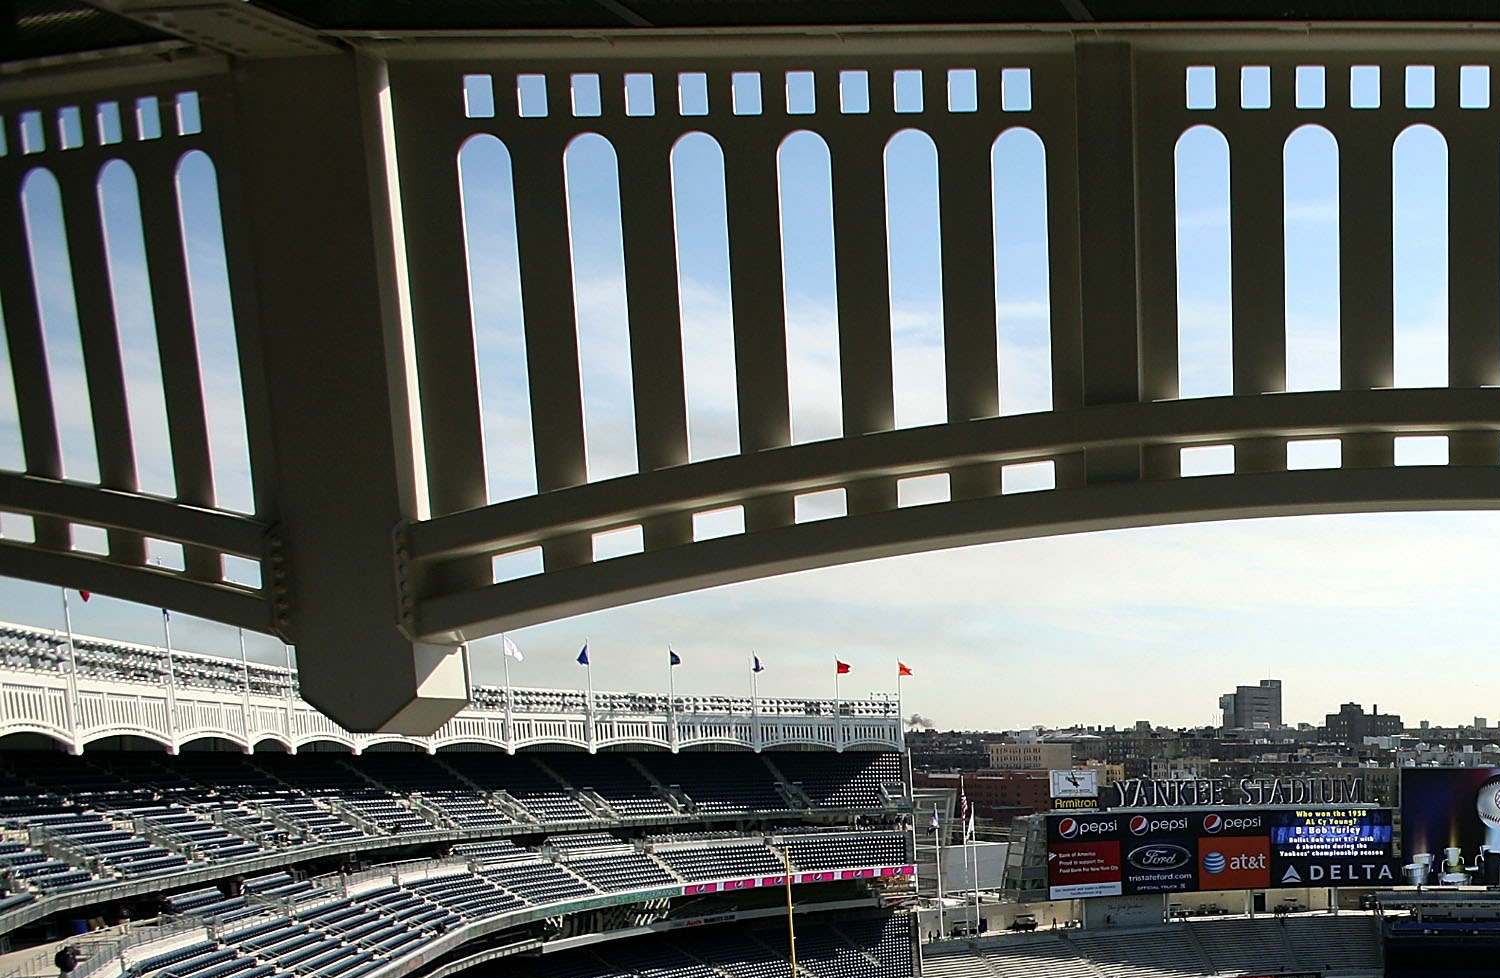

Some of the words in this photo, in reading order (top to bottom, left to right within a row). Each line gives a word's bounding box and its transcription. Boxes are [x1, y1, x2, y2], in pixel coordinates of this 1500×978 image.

[1113, 778, 1225, 808] YANKEE
[1239, 777, 1363, 805] STADIUM
[1054, 798, 1098, 809] Armitron
[1079, 819, 1118, 836] pepsi
[1150, 817, 1188, 833] pepsi
[1223, 816, 1262, 830] pepsi
[1329, 818, 1357, 826] Young?
[1295, 827, 1306, 835] B.
[1309, 826, 1329, 835] Bob
[1330, 826, 1361, 836] Turley
[1142, 850, 1177, 865] Ford
[1229, 853, 1267, 870] at&t
[1128, 873, 1192, 882] tristateford.com
[1309, 864, 1393, 881] DELTA
